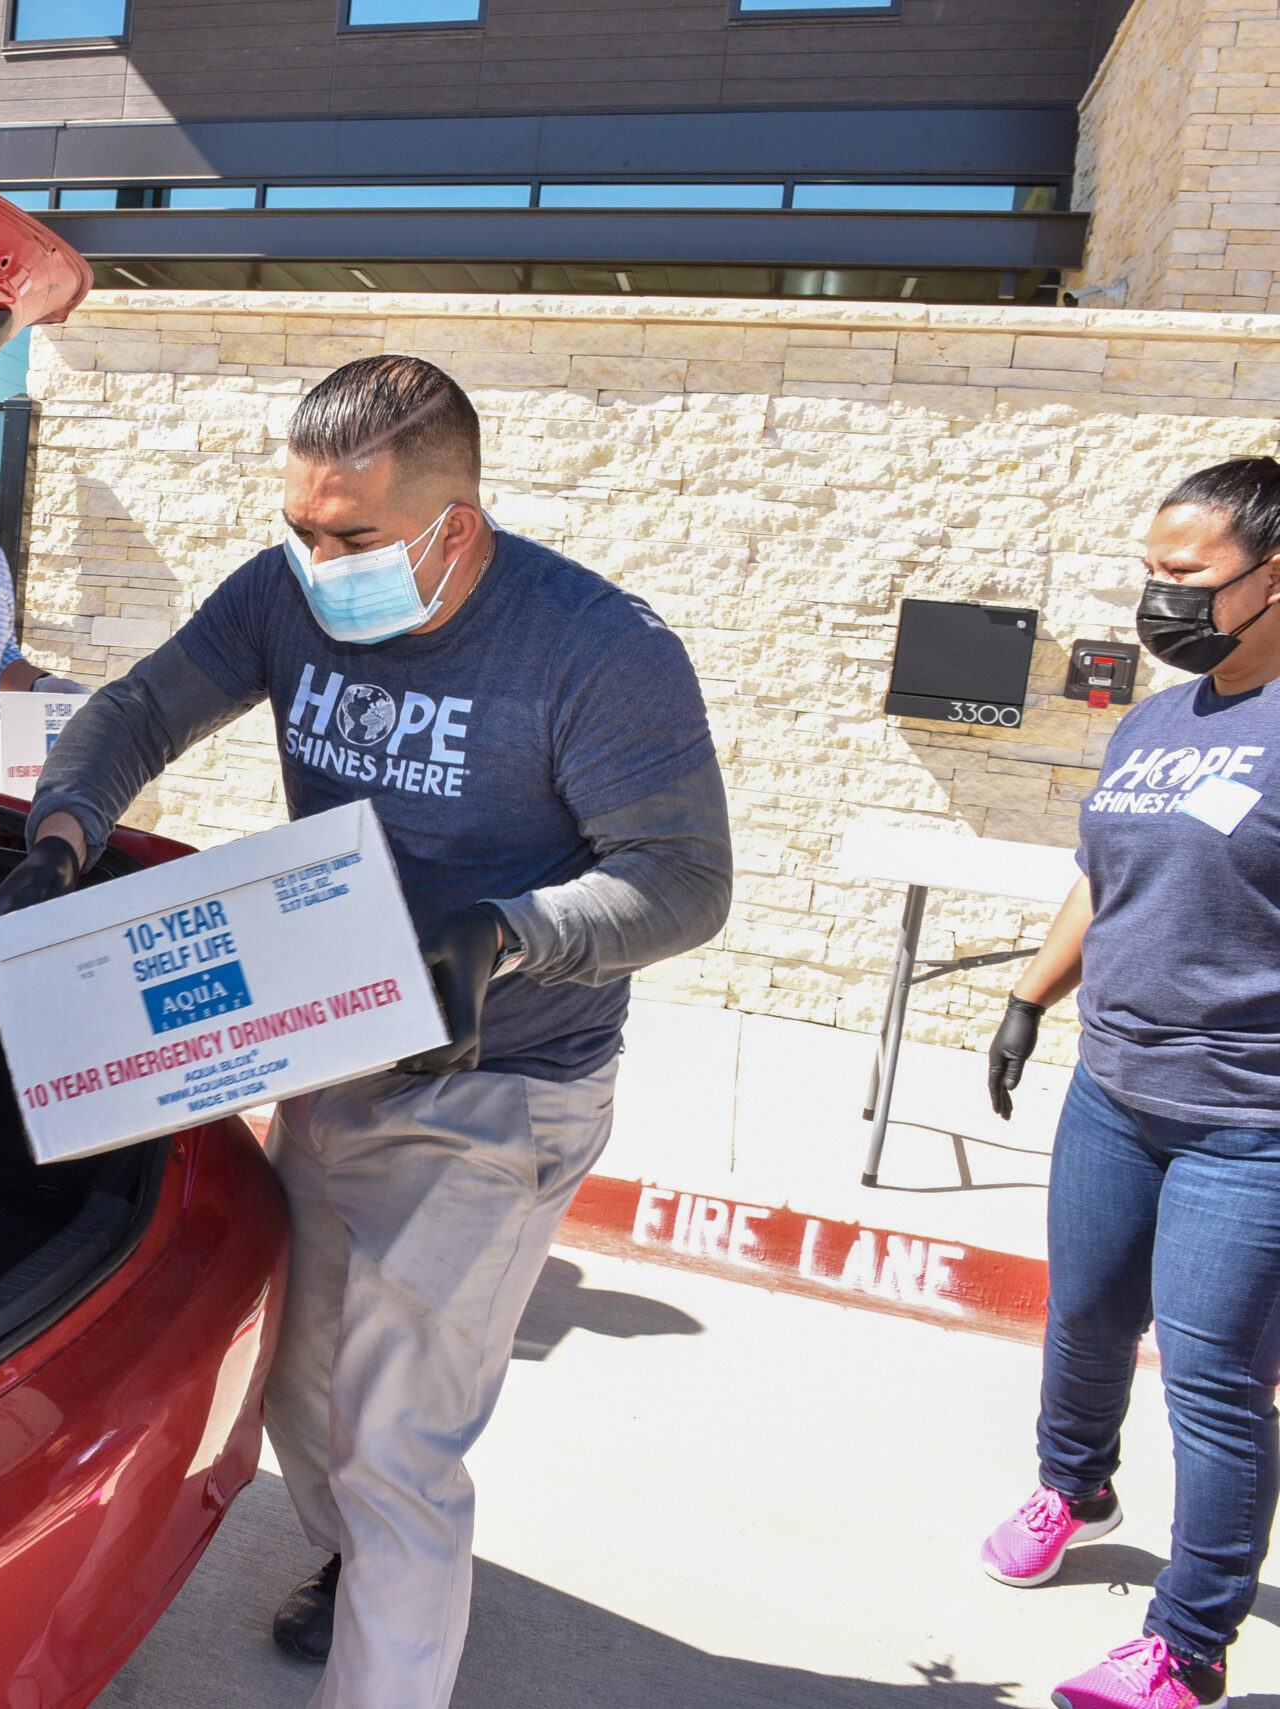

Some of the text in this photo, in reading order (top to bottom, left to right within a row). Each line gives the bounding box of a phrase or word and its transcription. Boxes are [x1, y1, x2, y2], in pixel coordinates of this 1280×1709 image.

[289, 663, 473, 764] HOPE
[948, 702, 1020, 727] 3300
[285, 728, 464, 797] SHINES HERE
[1089, 790, 1170, 814] SHINES
[123, 899, 228, 955] 10-YEAR
[133, 945, 191, 982] SHELF
[193, 931, 238, 964] LIFE
[163, 981, 229, 1016] AQUA
[22, 977, 403, 1110] 10 YEAR EMERGENCY DRINKING WATER
[156, 1058, 289, 1107] WWW.AQUABLOX.COM
[184, 1065, 218, 1083] AQUA
[188, 1080, 267, 1112] MADE IN USA
[632, 1185, 966, 1317] FIRE LANE
